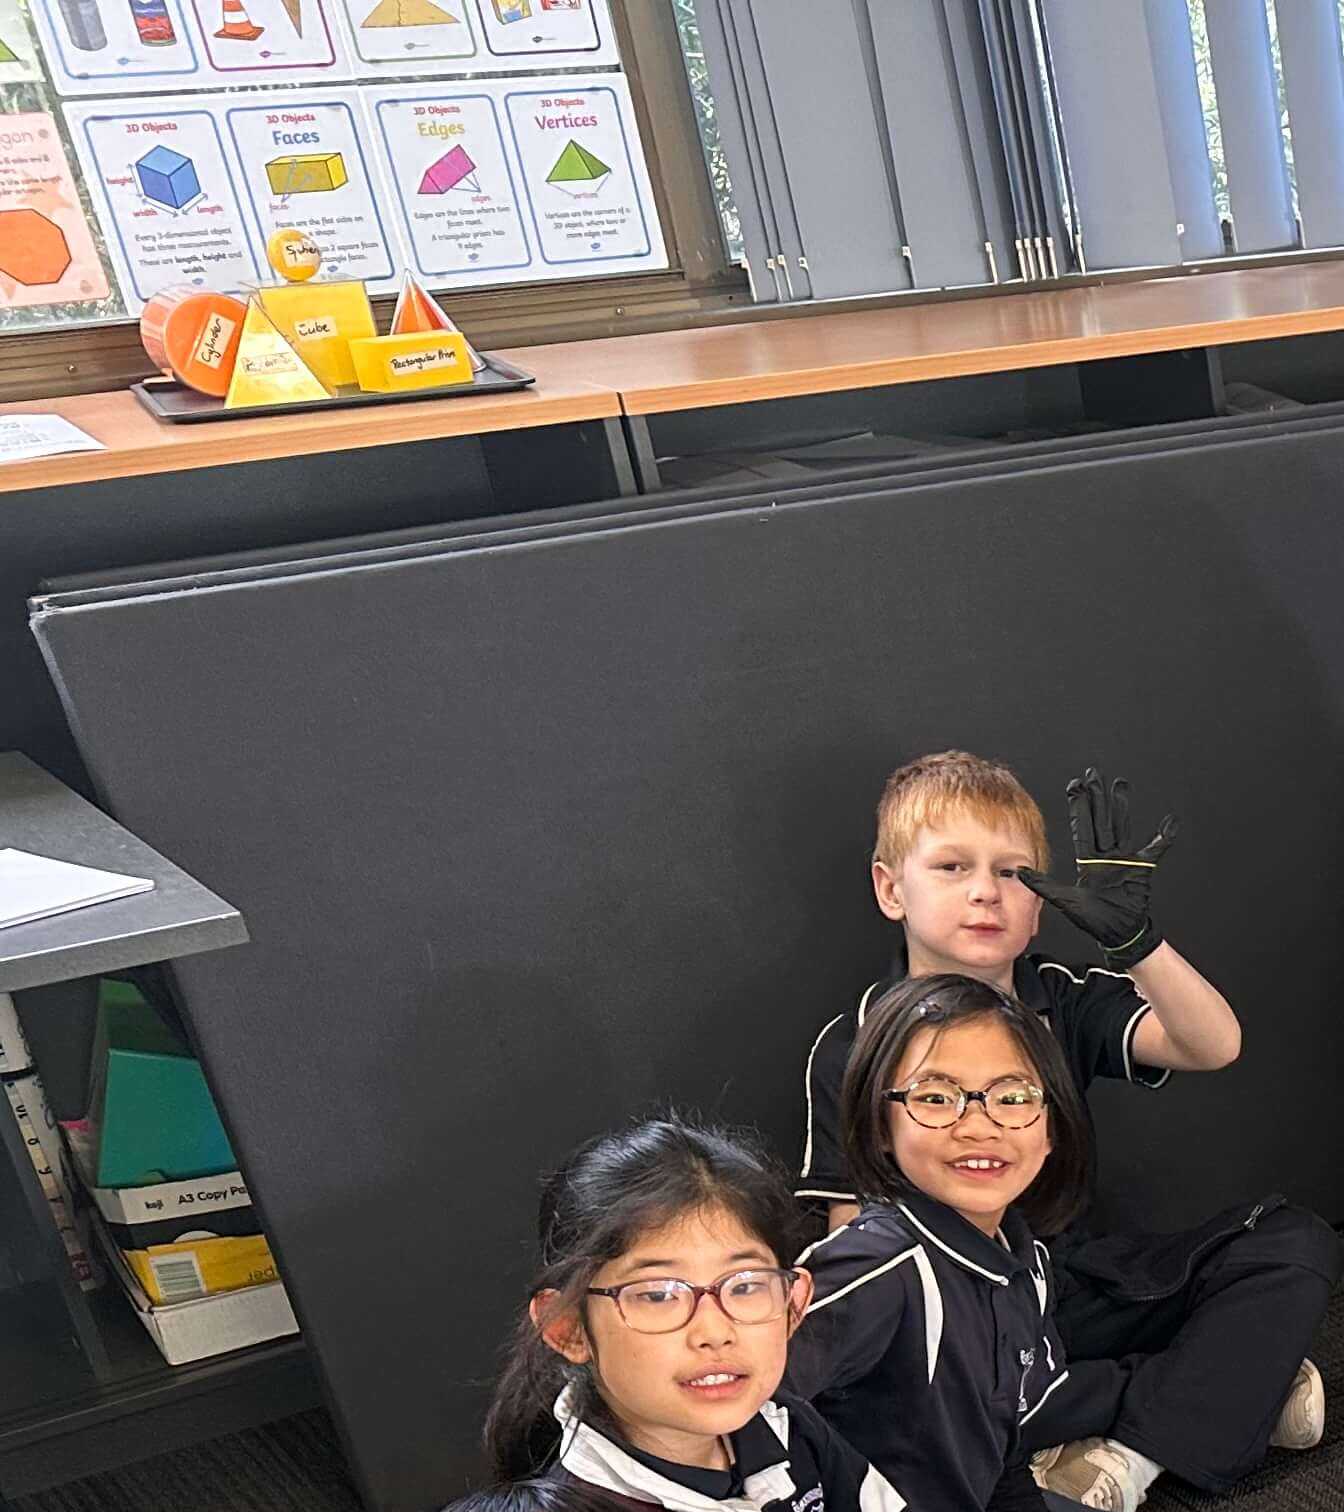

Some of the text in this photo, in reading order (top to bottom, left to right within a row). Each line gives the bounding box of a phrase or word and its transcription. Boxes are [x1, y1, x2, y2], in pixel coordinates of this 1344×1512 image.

[413, 105, 461, 116] 3D Objects
[541, 98, 585, 109] 3D Objects
[266, 113, 316, 125] 3D Objects
[534, 113, 598, 130] Vertices
[126, 122, 178, 134] 3D Objects
[417, 121, 466, 140] Edges
[272, 131, 320, 145] Faces
[298, 322, 330, 336] Cube
[201, 318, 222, 363] Cylinder
[178, 1195, 195, 1204] A3
[197, 1190, 228, 1201] Copy
